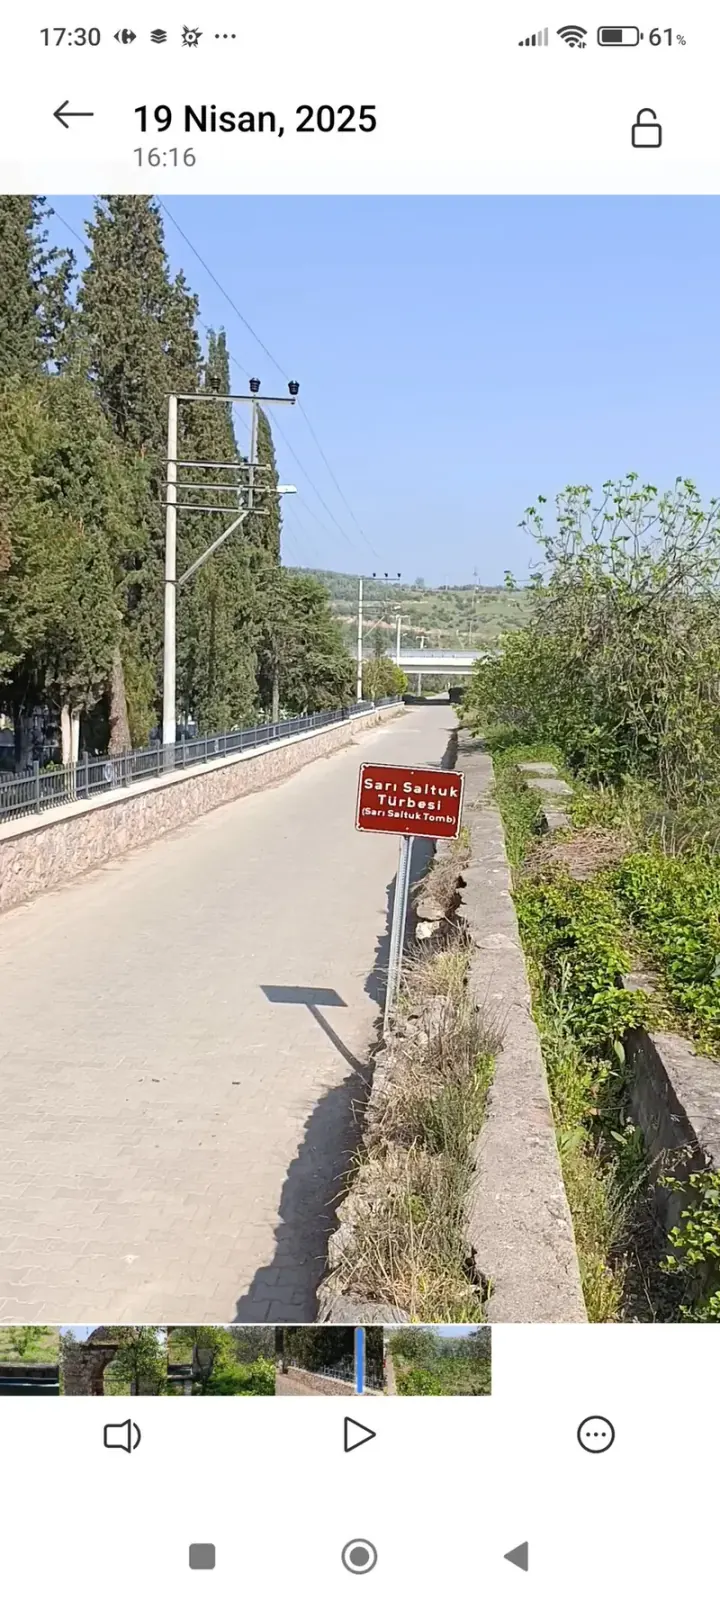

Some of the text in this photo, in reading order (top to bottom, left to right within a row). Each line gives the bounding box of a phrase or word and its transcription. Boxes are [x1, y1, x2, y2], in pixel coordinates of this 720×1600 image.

[364, 778, 458, 797] Sarı Saltuk
[378, 794, 441, 811] Türbesi
[362, 807, 456, 825] (Sarı Saltuk Tomb)
